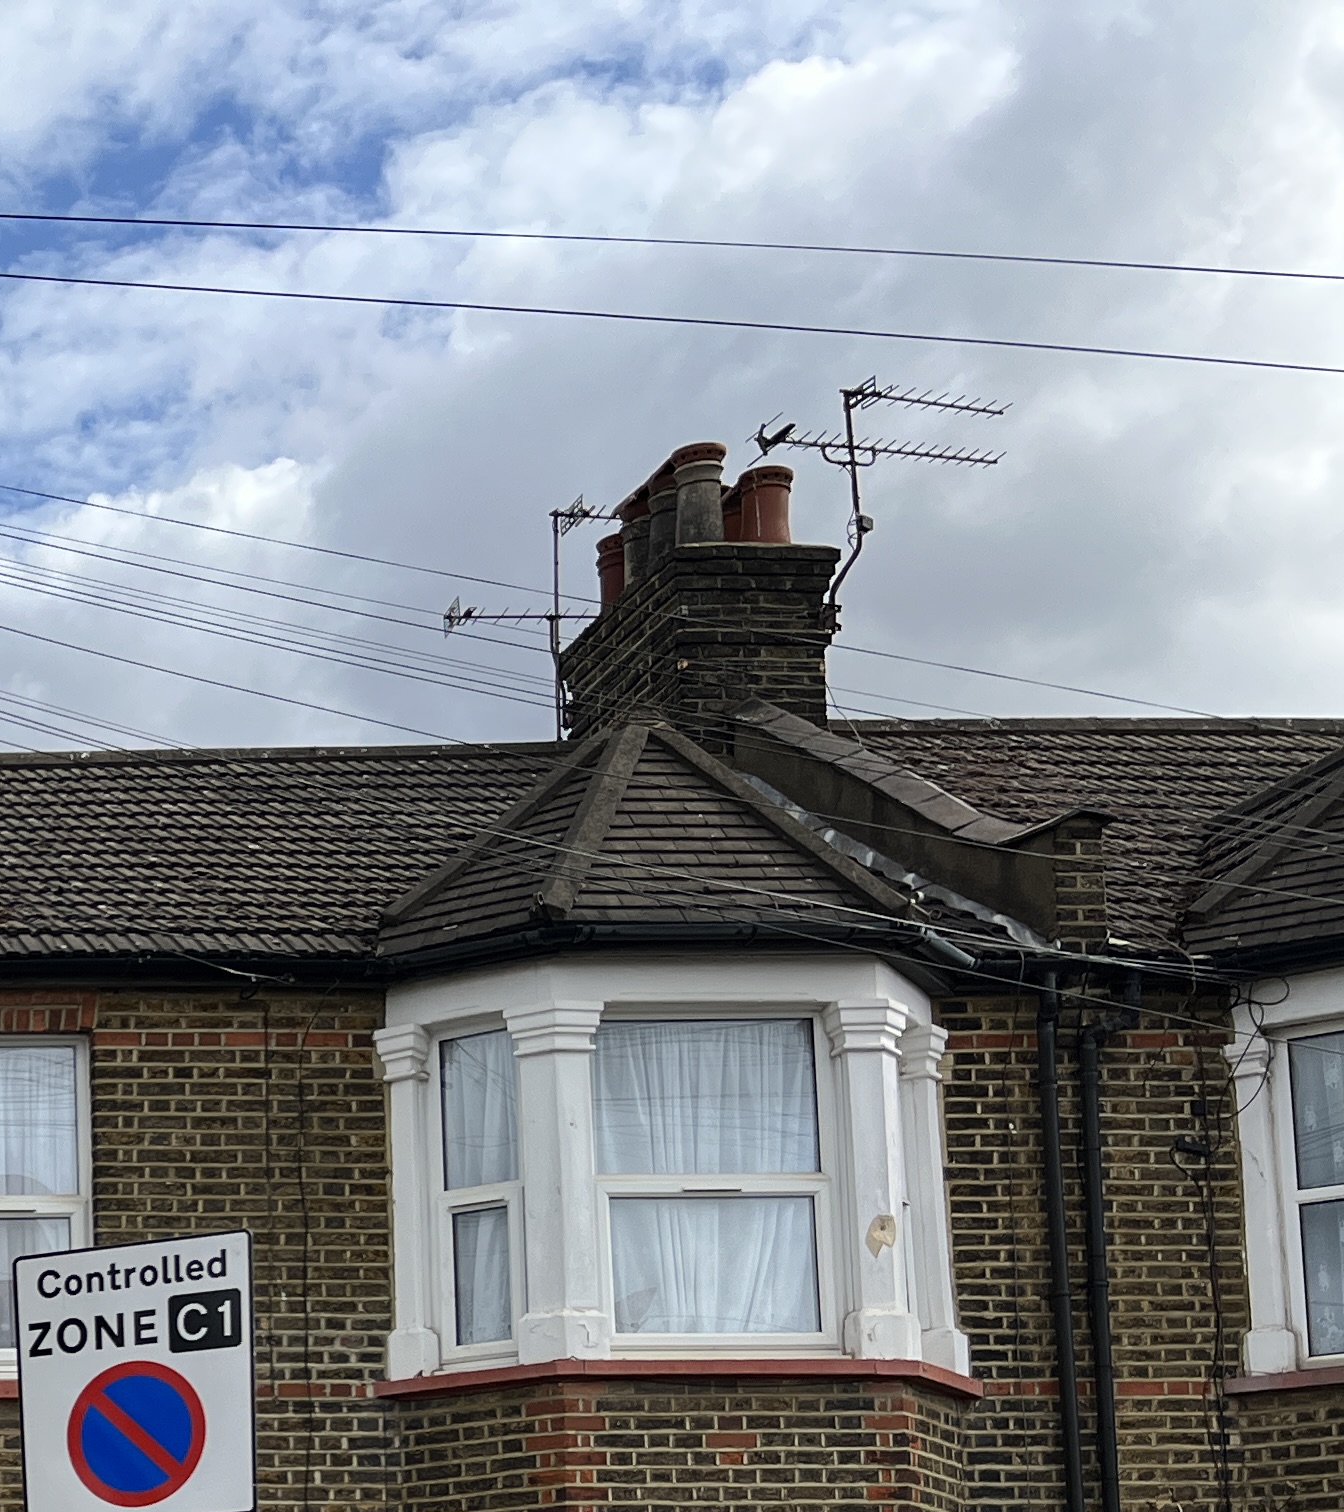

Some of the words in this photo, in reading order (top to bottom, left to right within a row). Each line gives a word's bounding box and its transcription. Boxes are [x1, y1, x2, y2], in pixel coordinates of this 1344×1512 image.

[37, 1249, 227, 1299] Controlled
[28, 1309, 158, 1357] ZONE
[176, 1300, 232, 1341] C1
